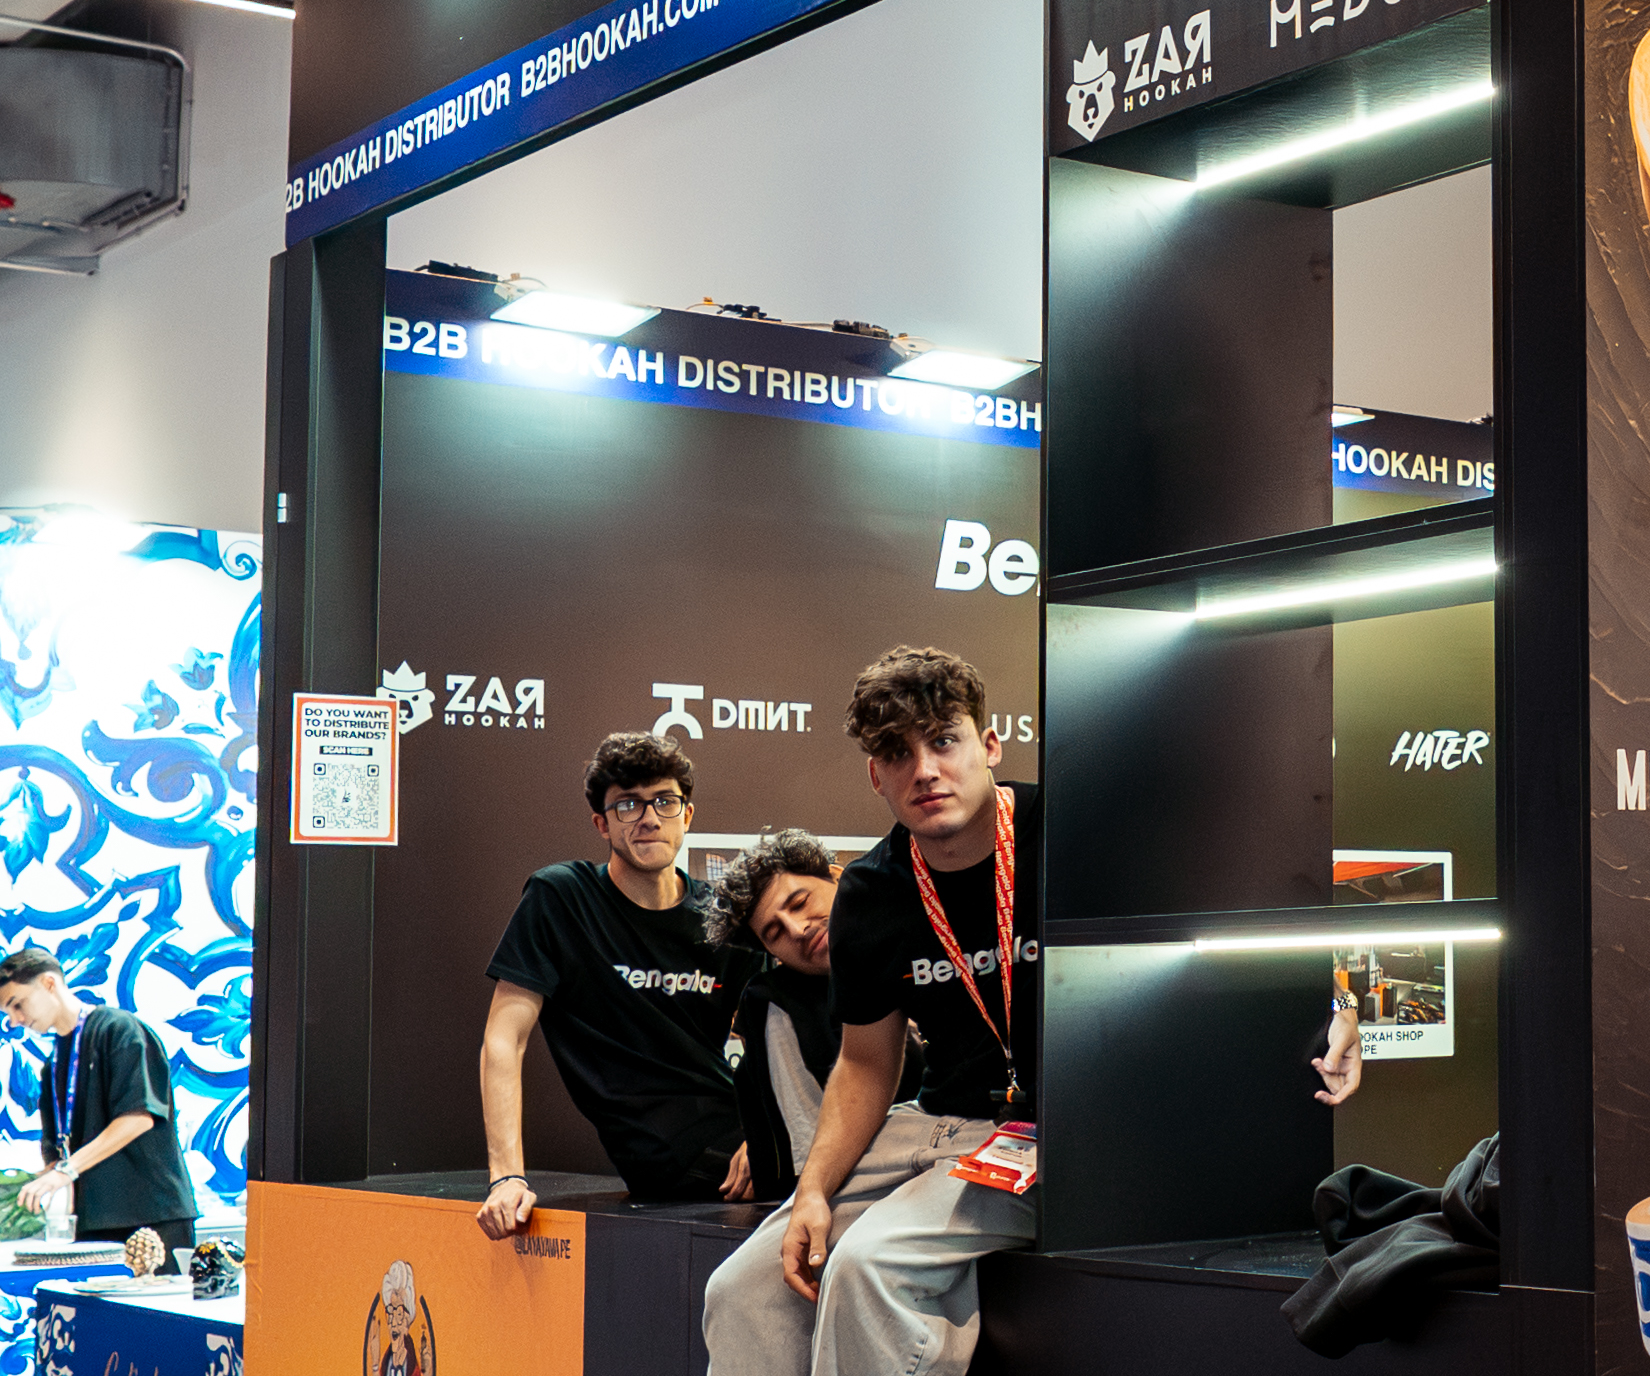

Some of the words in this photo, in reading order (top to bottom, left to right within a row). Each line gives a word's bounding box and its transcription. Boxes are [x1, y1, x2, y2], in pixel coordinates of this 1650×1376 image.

[1124, 68, 1212, 113] HOOKAH
[308, 140, 381, 203] HOOKAH
[385, 73, 510, 155] DISTRIBUTOR
[383, 317, 467, 360] B2B
[935, 518, 1040, 596] Be
[304, 708, 322, 717] DO
[326, 709, 350, 718] YOU
[352, 710, 389, 719] WANT
[305, 718, 321, 727] TO
[324, 719, 389, 730] DISTRIBUTE
[445, 714, 545, 730] HOOKAH
[304, 729, 330, 738] OUR
[333, 730, 387, 740] BRANDS?
[1389, 729, 1490, 773] HATER
[1396, 1030, 1424, 1042] SHOP
